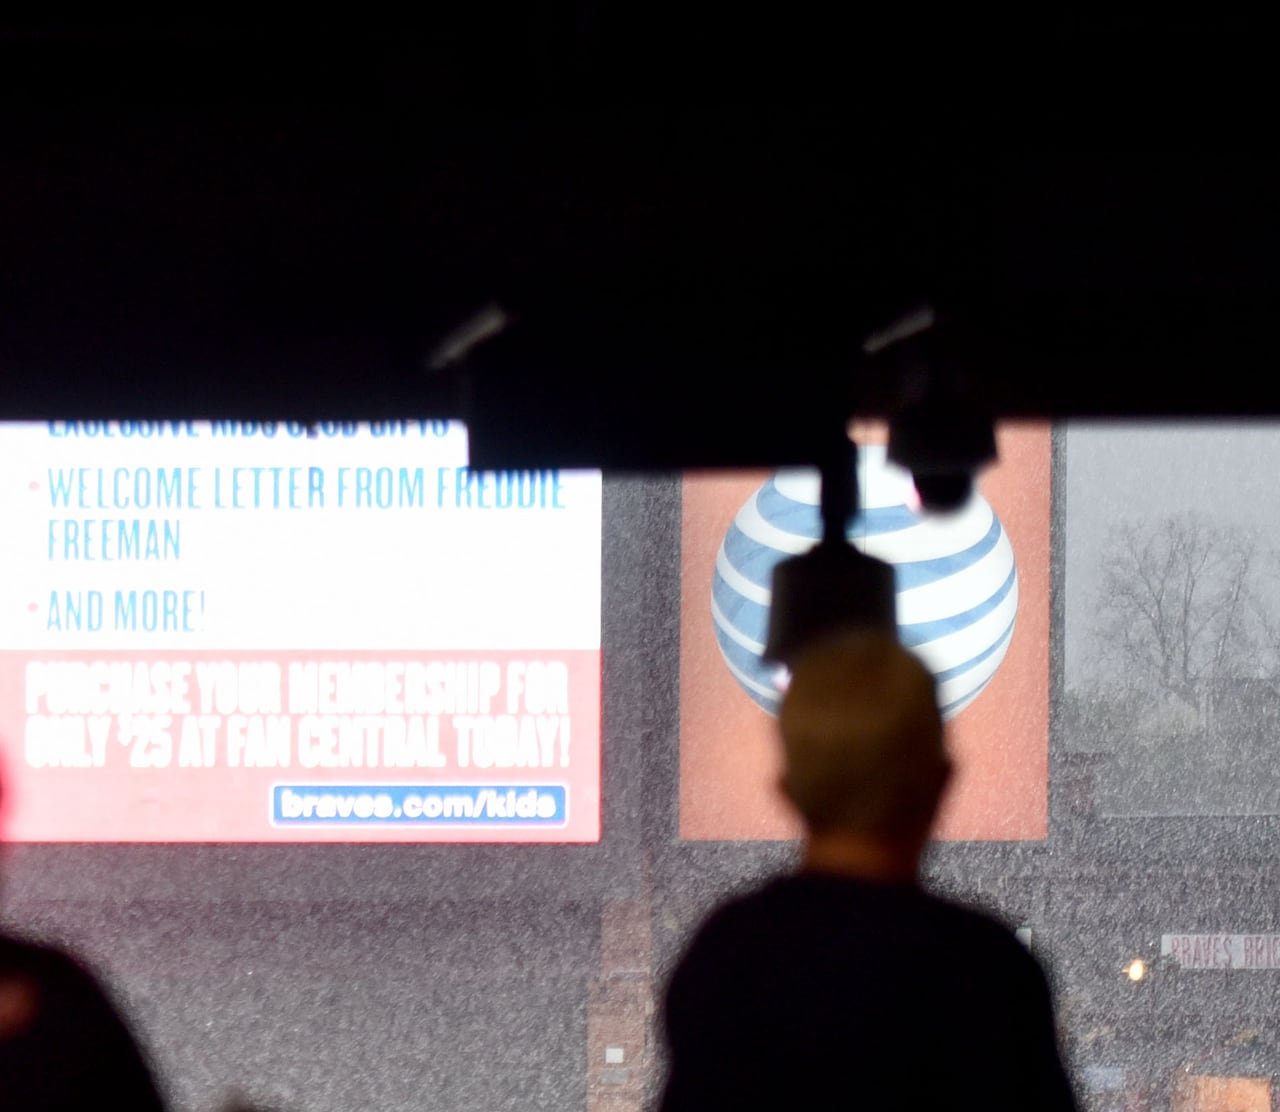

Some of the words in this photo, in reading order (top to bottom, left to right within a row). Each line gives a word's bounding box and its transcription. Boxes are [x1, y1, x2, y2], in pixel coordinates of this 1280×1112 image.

[48, 466, 201, 509] WELCOME
[214, 466, 325, 509] LETTER
[338, 466, 424, 509] FROM
[438, 466, 566, 509] FREDDIE
[48, 519, 181, 561] FREEMAN
[47, 589, 104, 632] AND
[114, 589, 206, 632] MORE!
[25, 661, 192, 715] PURCHASE
[195, 661, 282, 715] YOUR
[289, 661, 501, 715] MEMBERSHIP
[506, 661, 569, 715] FOR
[25, 714, 111, 768] ONLY
[178, 714, 222, 768] AT
[227, 714, 291, 768] FAN
[298, 714, 447, 768] CENTRAL
[452, 714, 571, 768] TODAY!
[281, 788, 557, 819] braves.com/kids
